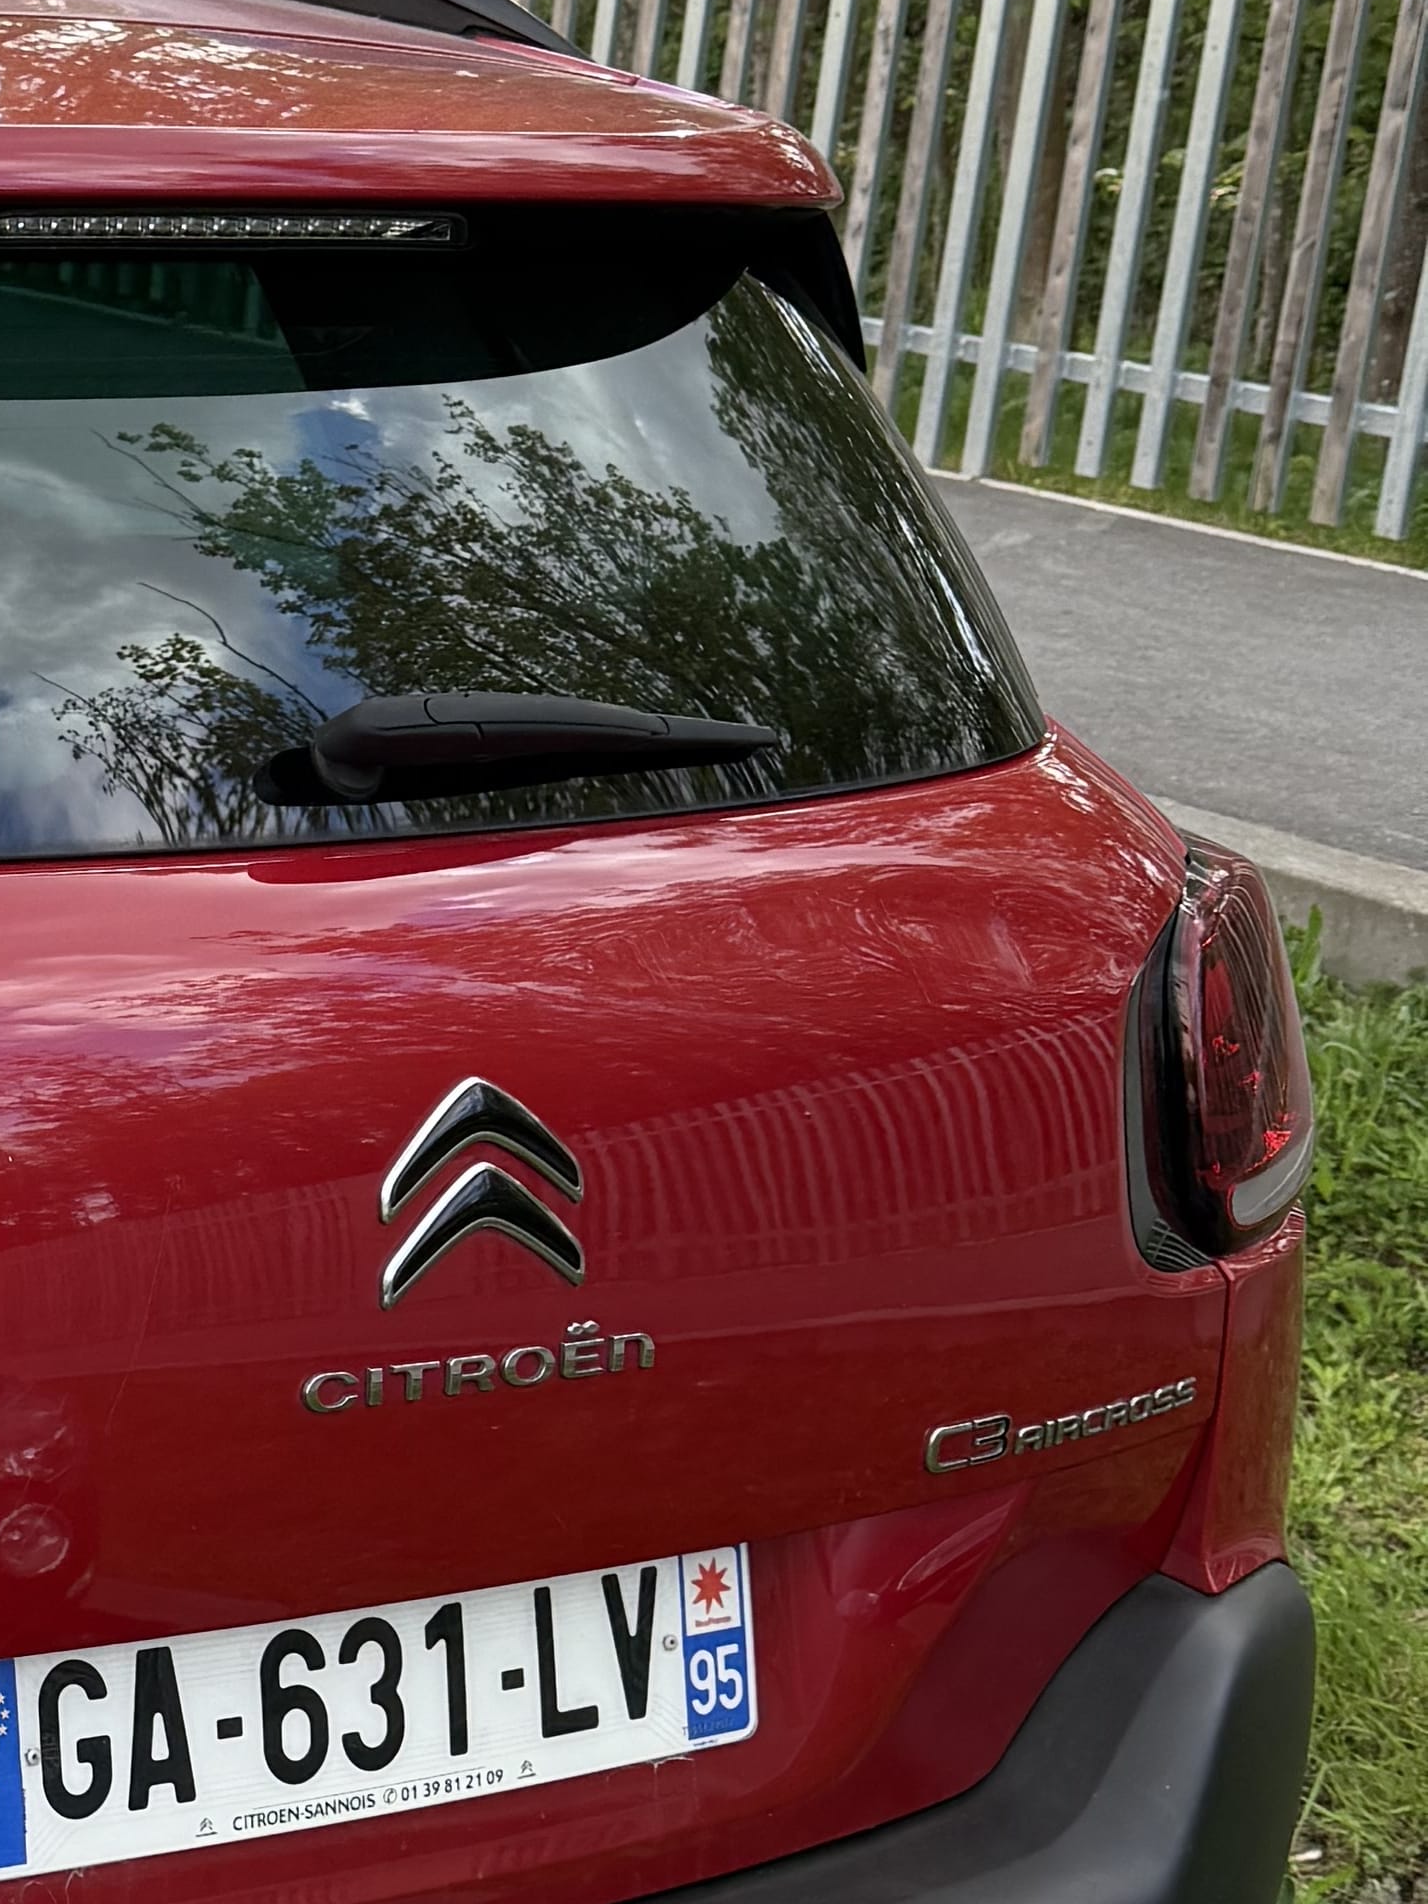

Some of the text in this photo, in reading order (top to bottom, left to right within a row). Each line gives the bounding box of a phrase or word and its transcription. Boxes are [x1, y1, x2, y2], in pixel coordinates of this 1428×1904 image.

[925, 1377, 1196, 1473] C3 AIRCROSS
[38, 1565, 658, 1820] GA-631-LV
[689, 1643, 744, 1715] 95
[232, 1769, 504, 1831] CITROEN-SANNOIS 01 39 81 21 09
